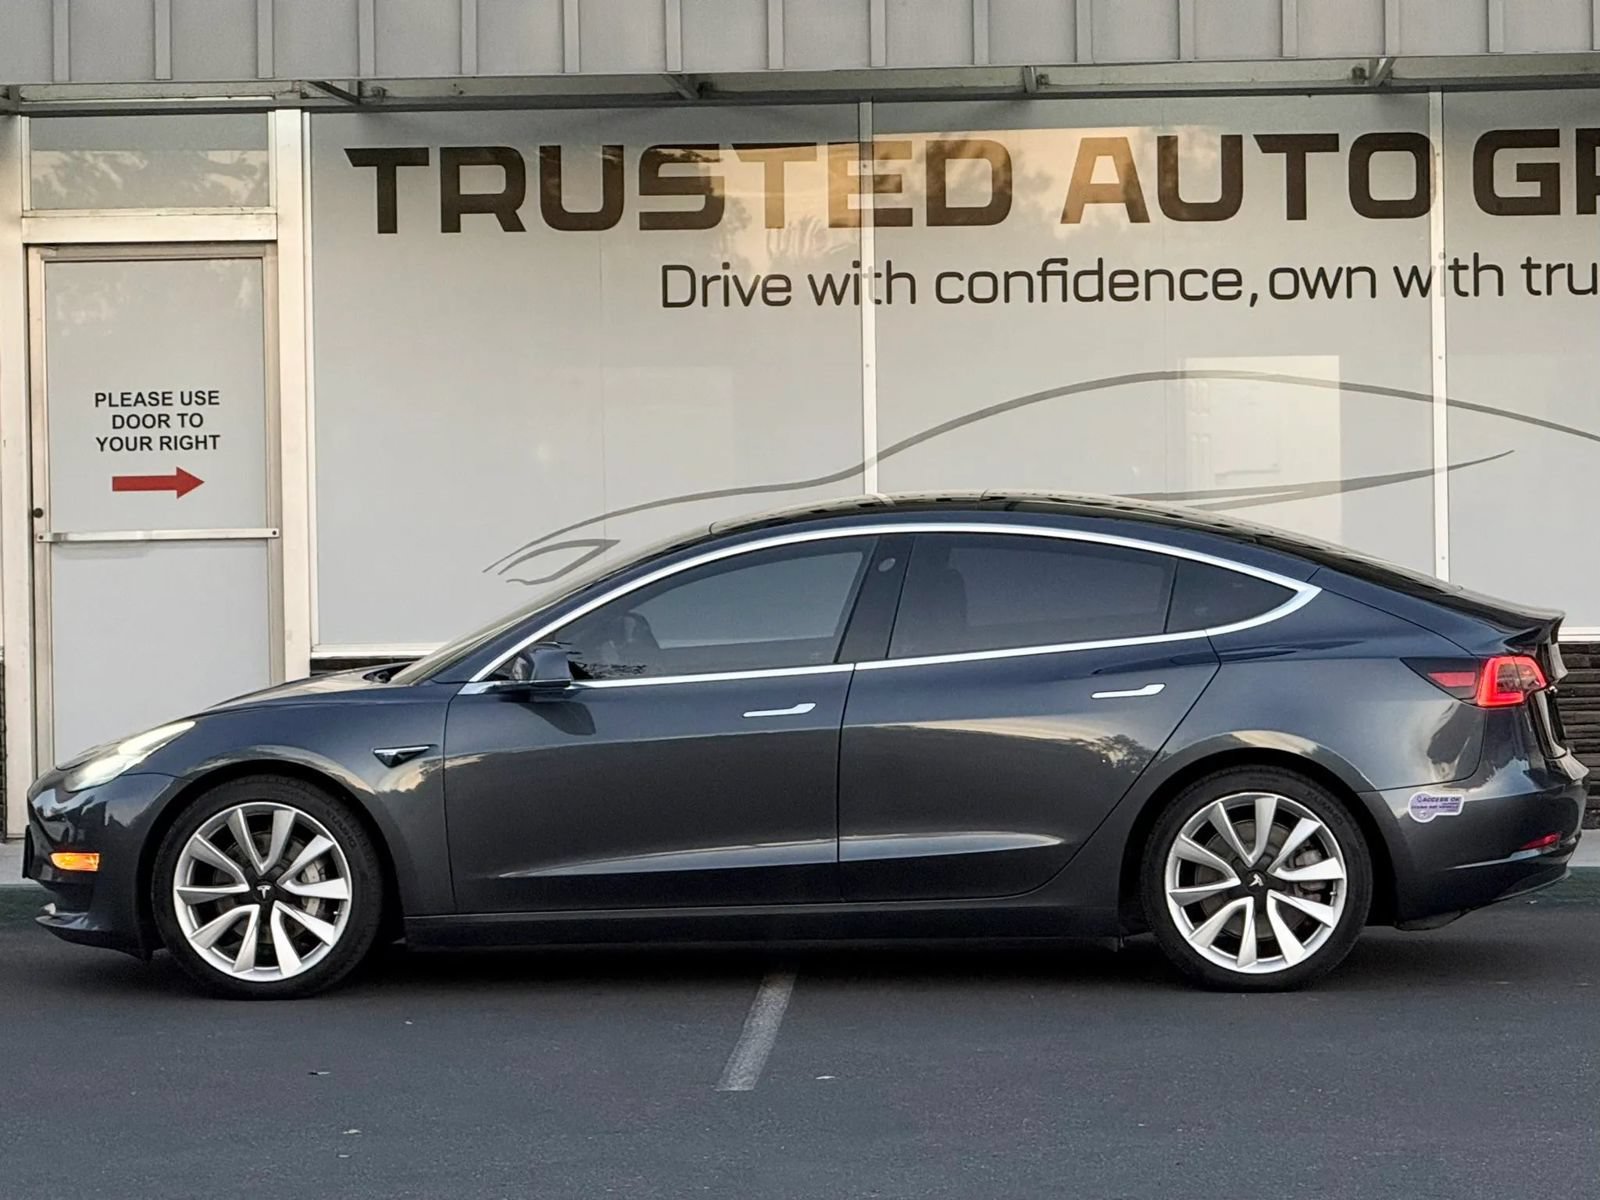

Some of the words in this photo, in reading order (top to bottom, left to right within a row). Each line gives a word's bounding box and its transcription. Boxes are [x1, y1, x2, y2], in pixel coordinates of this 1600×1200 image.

[344, 138, 1013, 234] TRUSTED
[1059, 131, 1436, 225] AUTO
[1473, 128, 1600, 216] G
[661, 261, 793, 309] Drive
[807, 259, 917, 306] with
[935, 257, 1259, 308] confidence,
[1268, 265, 1377, 300] own
[94, 391, 174, 408] PLEASE
[180, 390, 220, 406] USE
[111, 413, 171, 430] DOOR
[176, 412, 204, 428] TO
[95, 435, 153, 452] YOUR
[159, 434, 221, 451] RIGHT
